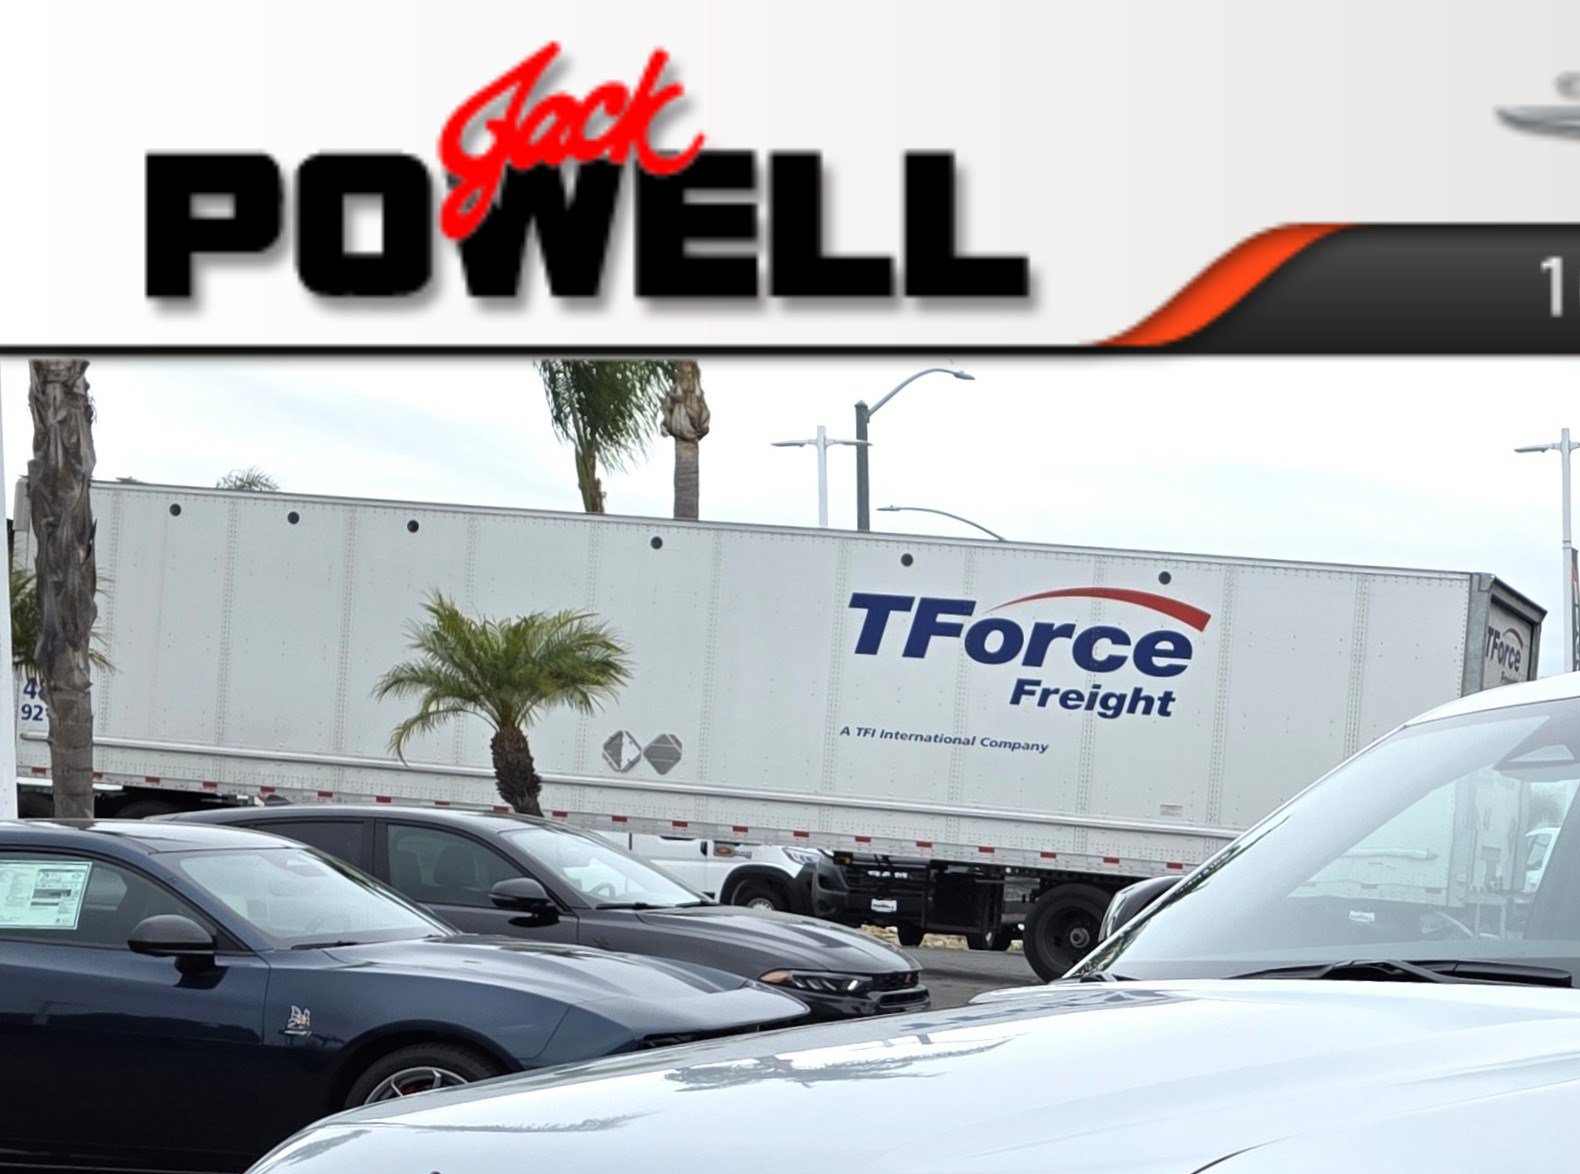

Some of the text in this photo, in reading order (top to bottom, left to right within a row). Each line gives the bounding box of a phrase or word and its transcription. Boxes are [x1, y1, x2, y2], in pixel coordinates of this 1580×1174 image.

[848, 592, 1193, 678] TForce
[1485, 625, 1521, 672] TForce
[1009, 678, 1177, 719] Freight
[839, 726, 1049, 754] A TFI International Company
